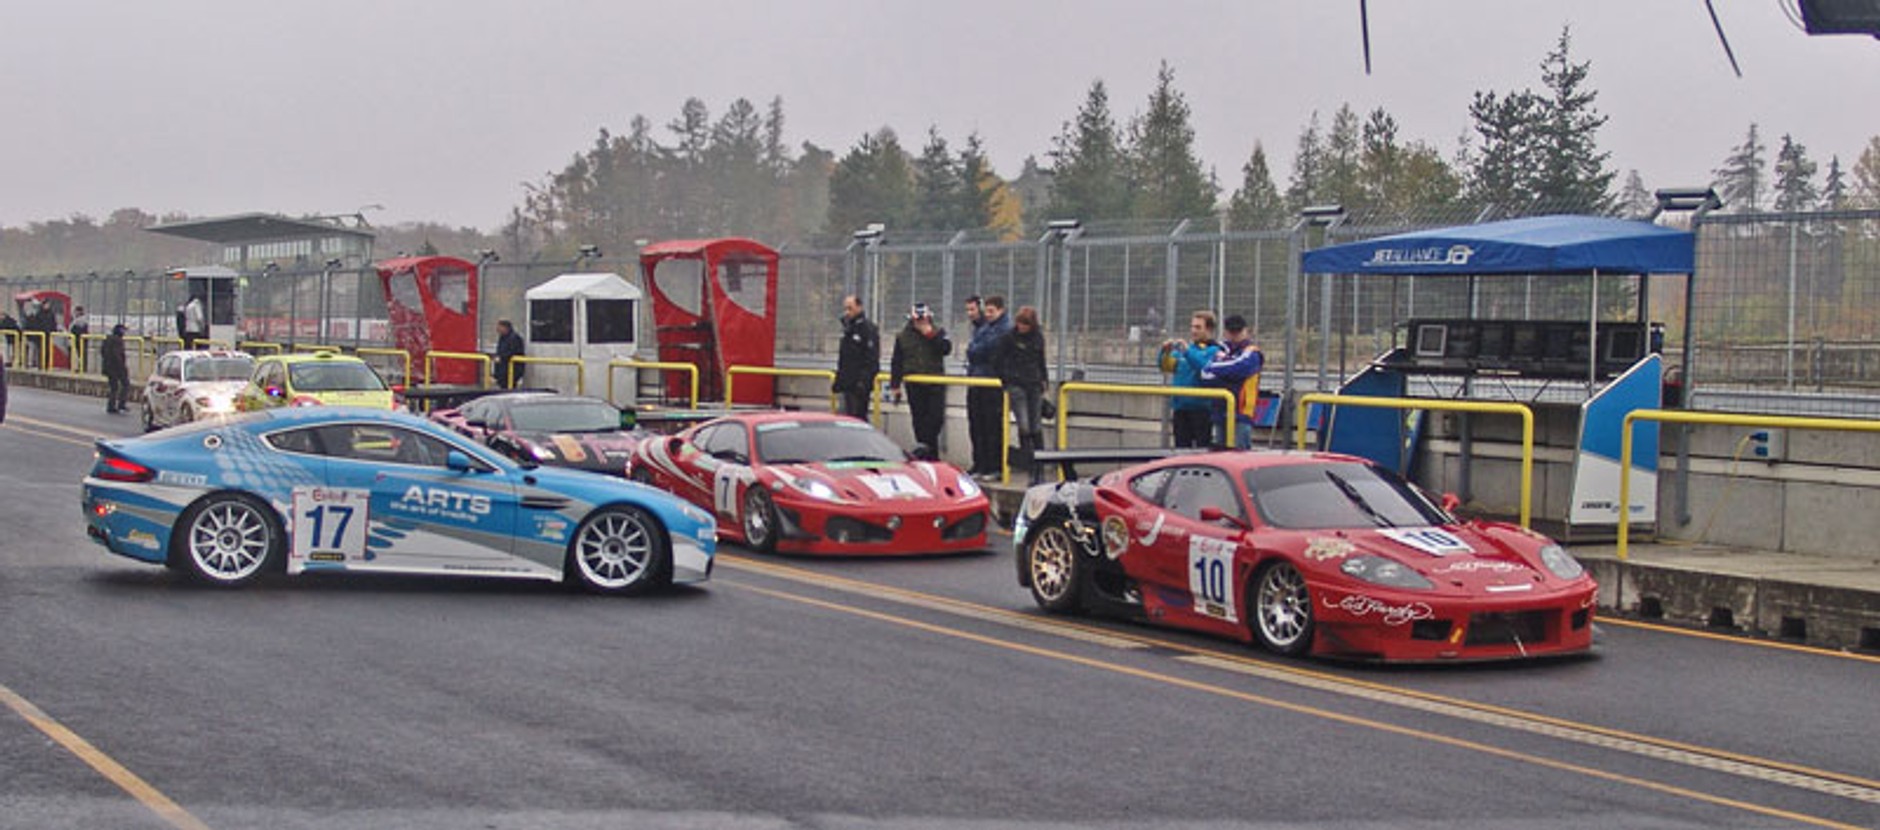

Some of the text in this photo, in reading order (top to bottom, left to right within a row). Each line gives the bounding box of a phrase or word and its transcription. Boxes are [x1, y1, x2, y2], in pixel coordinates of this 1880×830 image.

[402, 485, 490, 514] ARTS
[721, 476, 730, 509] 7
[305, 505, 354, 549] 17
[1403, 530, 1460, 548] 10
[1194, 556, 1226, 604] 10
